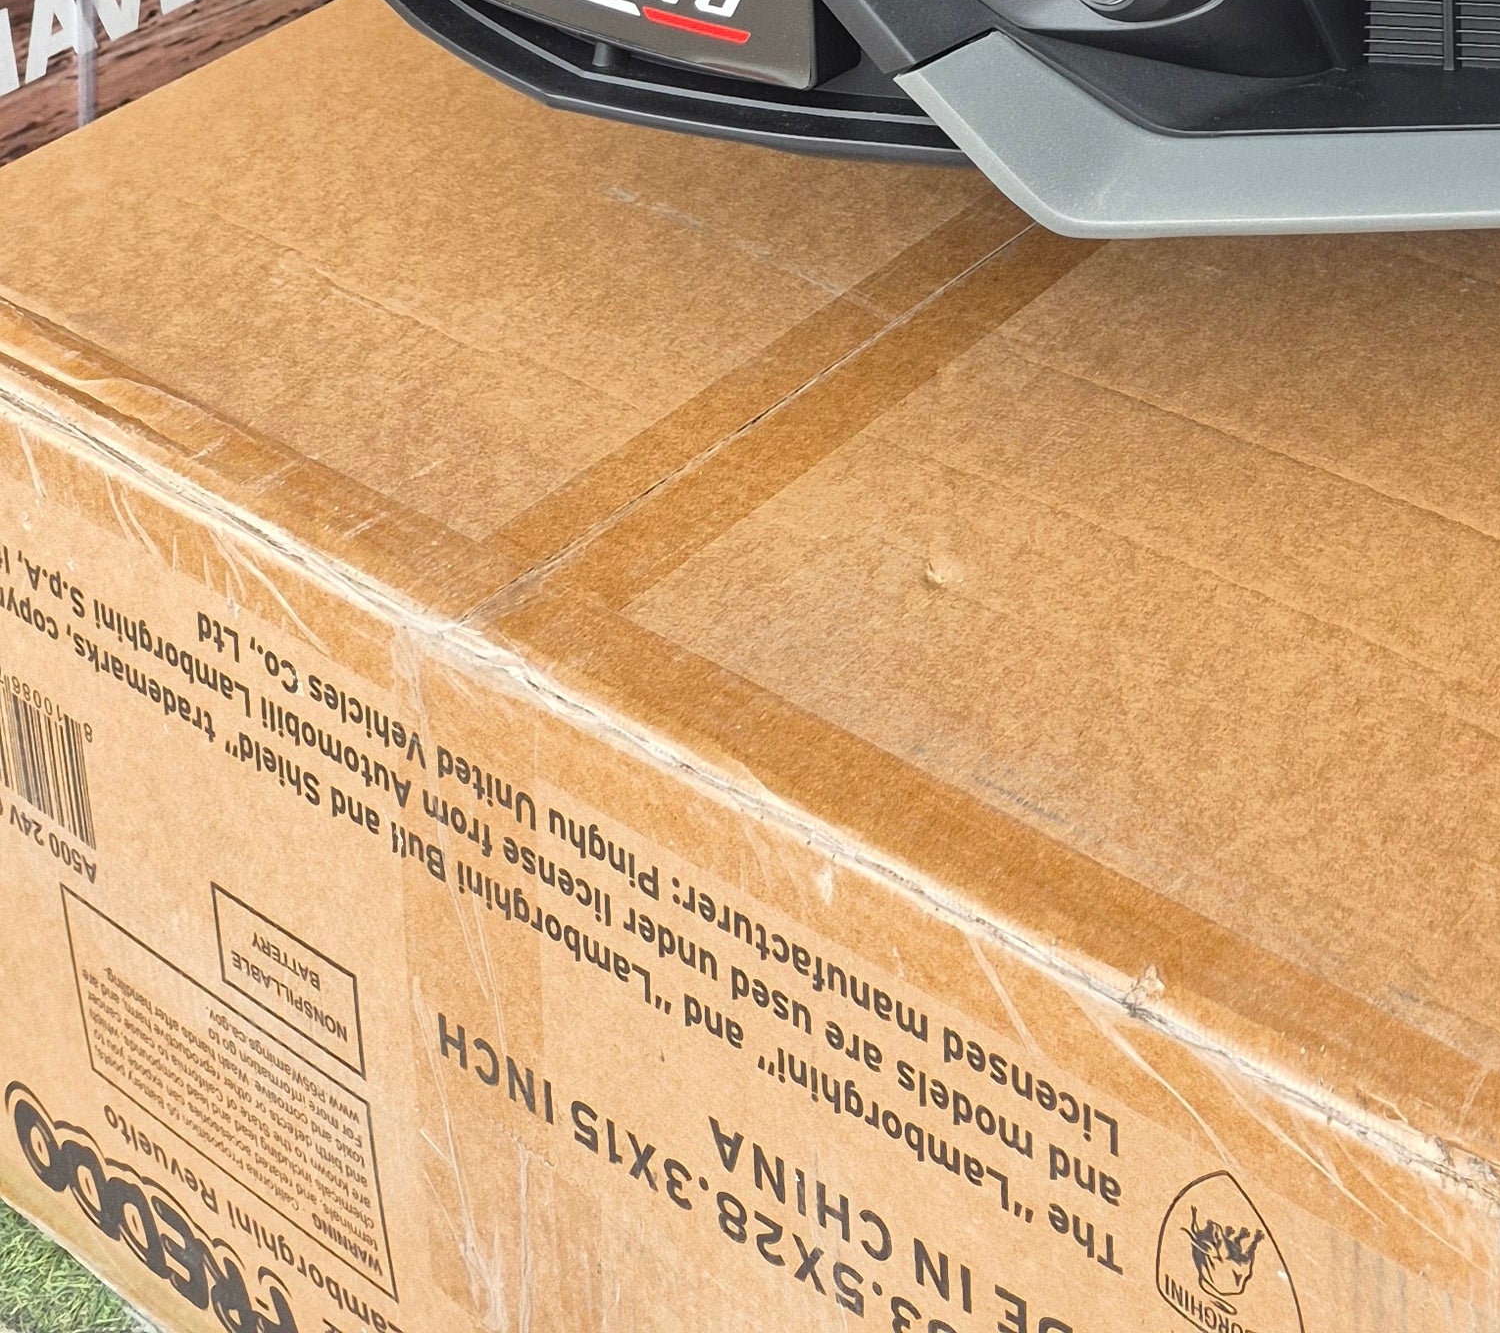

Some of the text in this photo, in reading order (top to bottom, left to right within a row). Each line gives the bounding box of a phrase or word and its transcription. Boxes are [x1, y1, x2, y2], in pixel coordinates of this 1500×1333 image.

[67, 624, 215, 742] trademarks,
[10, 805, 96, 884] A500 24V
[331, 786, 379, 834] and
[18, 550, 1121, 1206] and models are used under license from Automobili Lamborghini S.p.A,
[198, 612, 1119, 1157] Licensed manufacturer: Pinghu United Vehicles Co., Ltd
[391, 822, 446, 882] Bull
[231, 950, 347, 1042] NONSPILLABLE
[252, 933, 320, 991] BATTERY
[684, 994, 743, 1049] and
[204, 1021, 365, 1153] For more information go to
[315, 1144, 343, 1173] birth
[342, 1159, 370, 1195] and
[438, 1013, 957, 1333] 3.5X28.3X15 INCH
[103, 1105, 404, 1333] amborghini Revuelto
[312, 1213, 382, 1276] WARNING
[709, 1116, 972, 1314] IN CHINA
[1048, 1203, 1123, 1275] The
